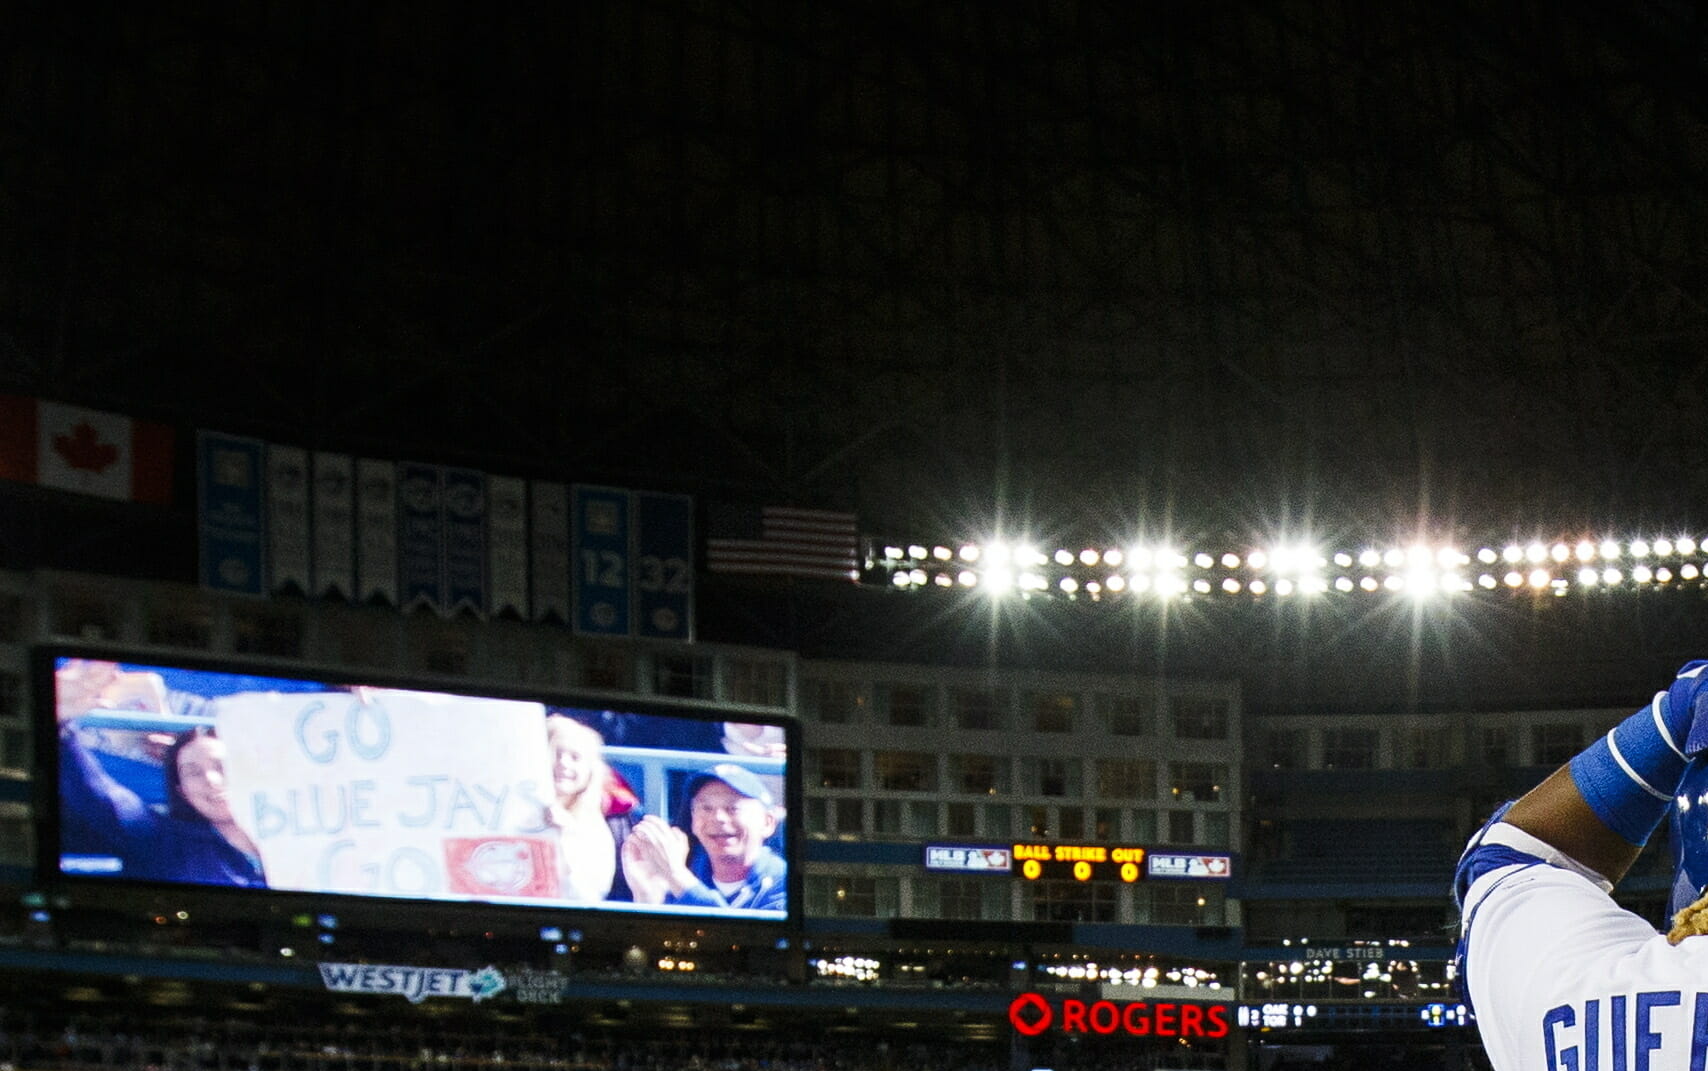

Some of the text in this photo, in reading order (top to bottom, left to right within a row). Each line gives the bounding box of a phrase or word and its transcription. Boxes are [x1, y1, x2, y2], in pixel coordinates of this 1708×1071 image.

[581, 548, 625, 588] 12
[640, 554, 689, 594] 32
[294, 698, 391, 764] GO
[1055, 846, 1107, 863] STRIKE
[1111, 848, 1145, 864] OUT
[1306, 948, 1340, 959] DAVE
[323, 967, 465, 1001] WESTJET
[1063, 999, 1229, 1038] ROGERS
